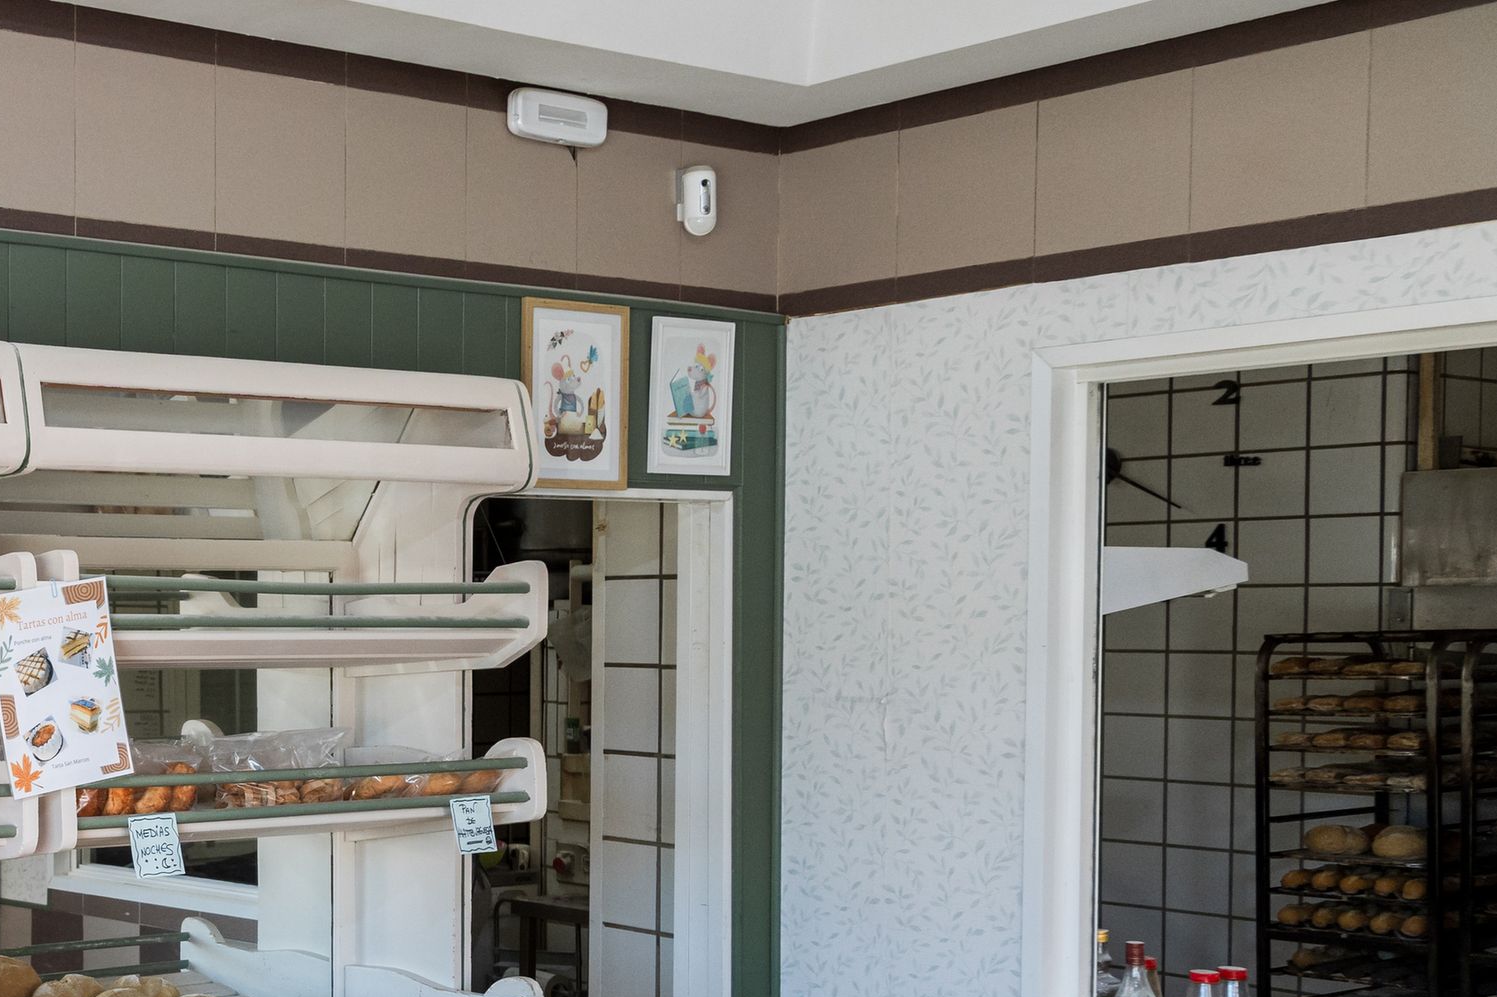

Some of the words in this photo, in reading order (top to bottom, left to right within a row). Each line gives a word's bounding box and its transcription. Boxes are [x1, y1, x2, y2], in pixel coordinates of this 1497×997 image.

[1212, 379, 1241, 406] 2
[1205, 523, 1229, 553] 4
[17, 619, 46, 632] Tartas
[47, 616, 64, 626] con
[66, 611, 88, 622] alma
[459, 801, 478, 814] PAN
[141, 842, 174, 858] NOCHES
